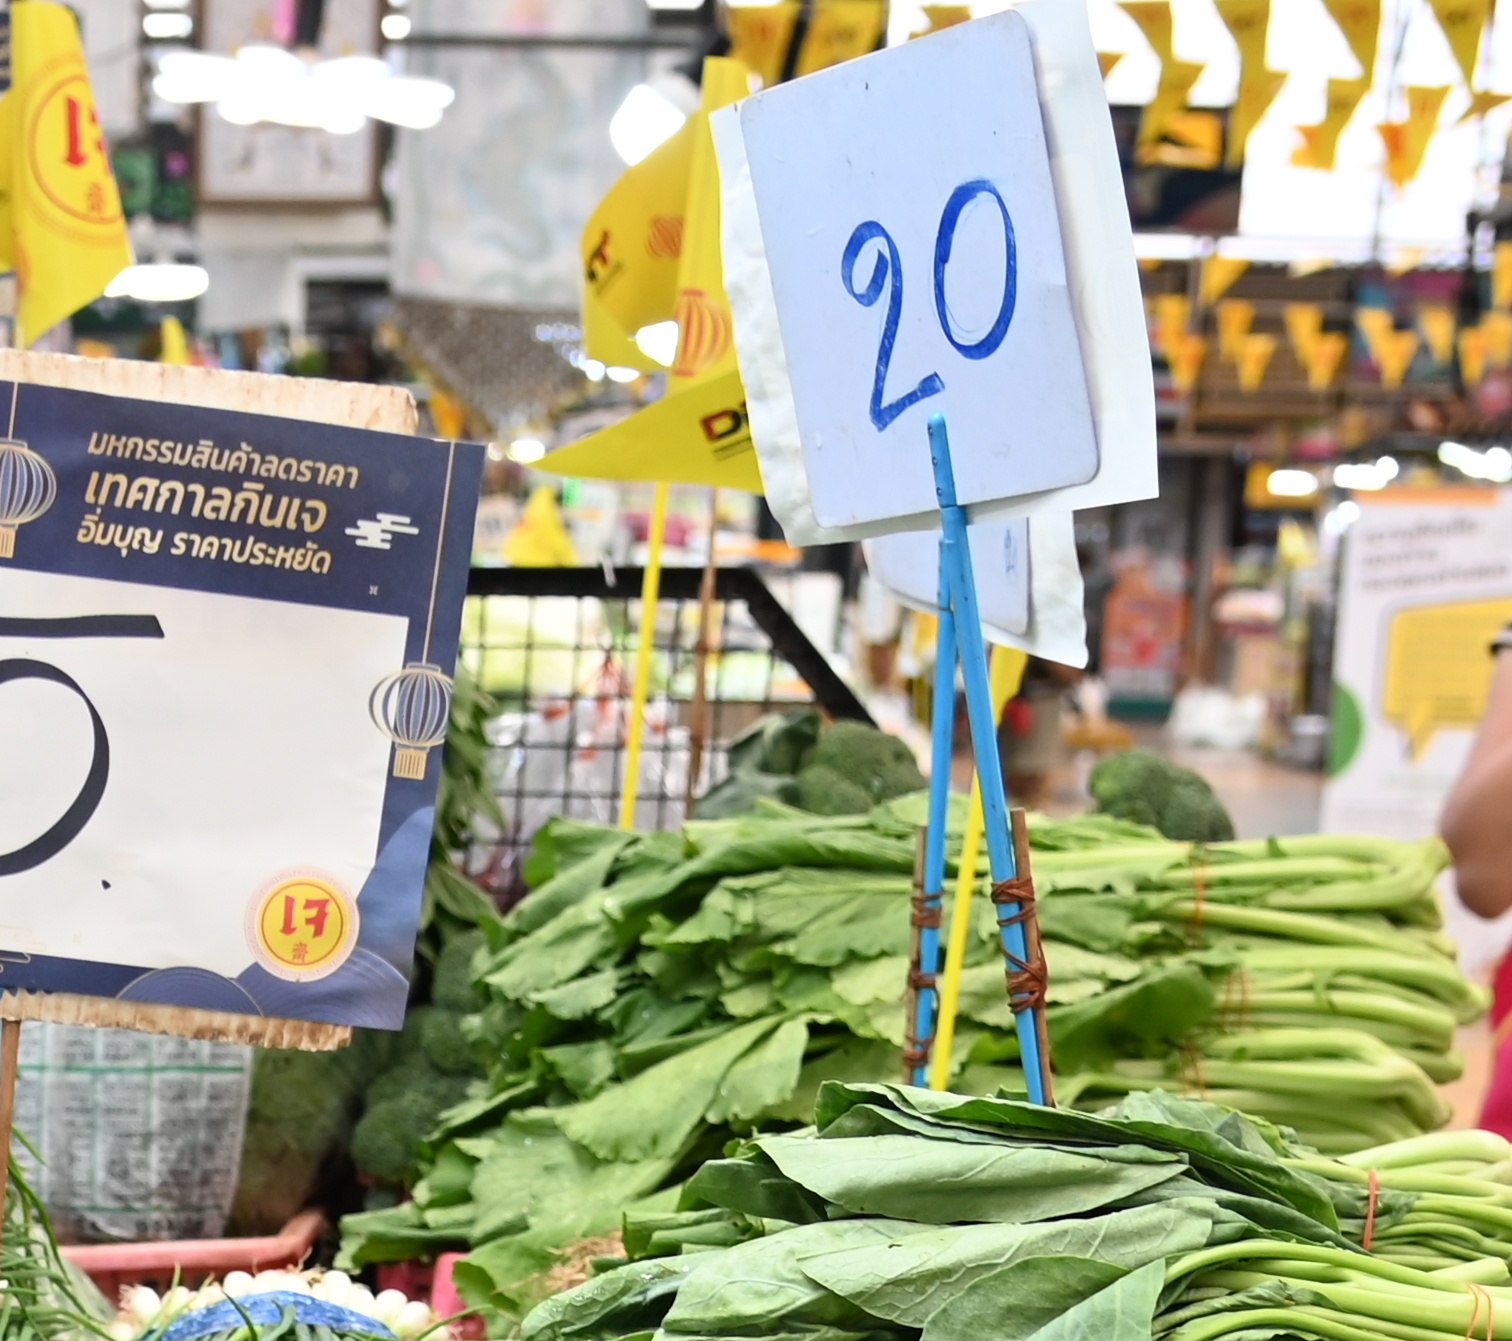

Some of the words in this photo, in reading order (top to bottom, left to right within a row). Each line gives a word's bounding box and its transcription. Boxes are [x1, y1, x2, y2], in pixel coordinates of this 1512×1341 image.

[840, 178, 1018, 433] 20
[87, 431, 360, 490] มหกรรมสินค้าลดราคา
[84, 470, 328, 534] เทศกาลกินเจ
[76, 506, 163, 558] อิ่มบุญ
[170, 532, 333, 575] ราคาประหยัด
